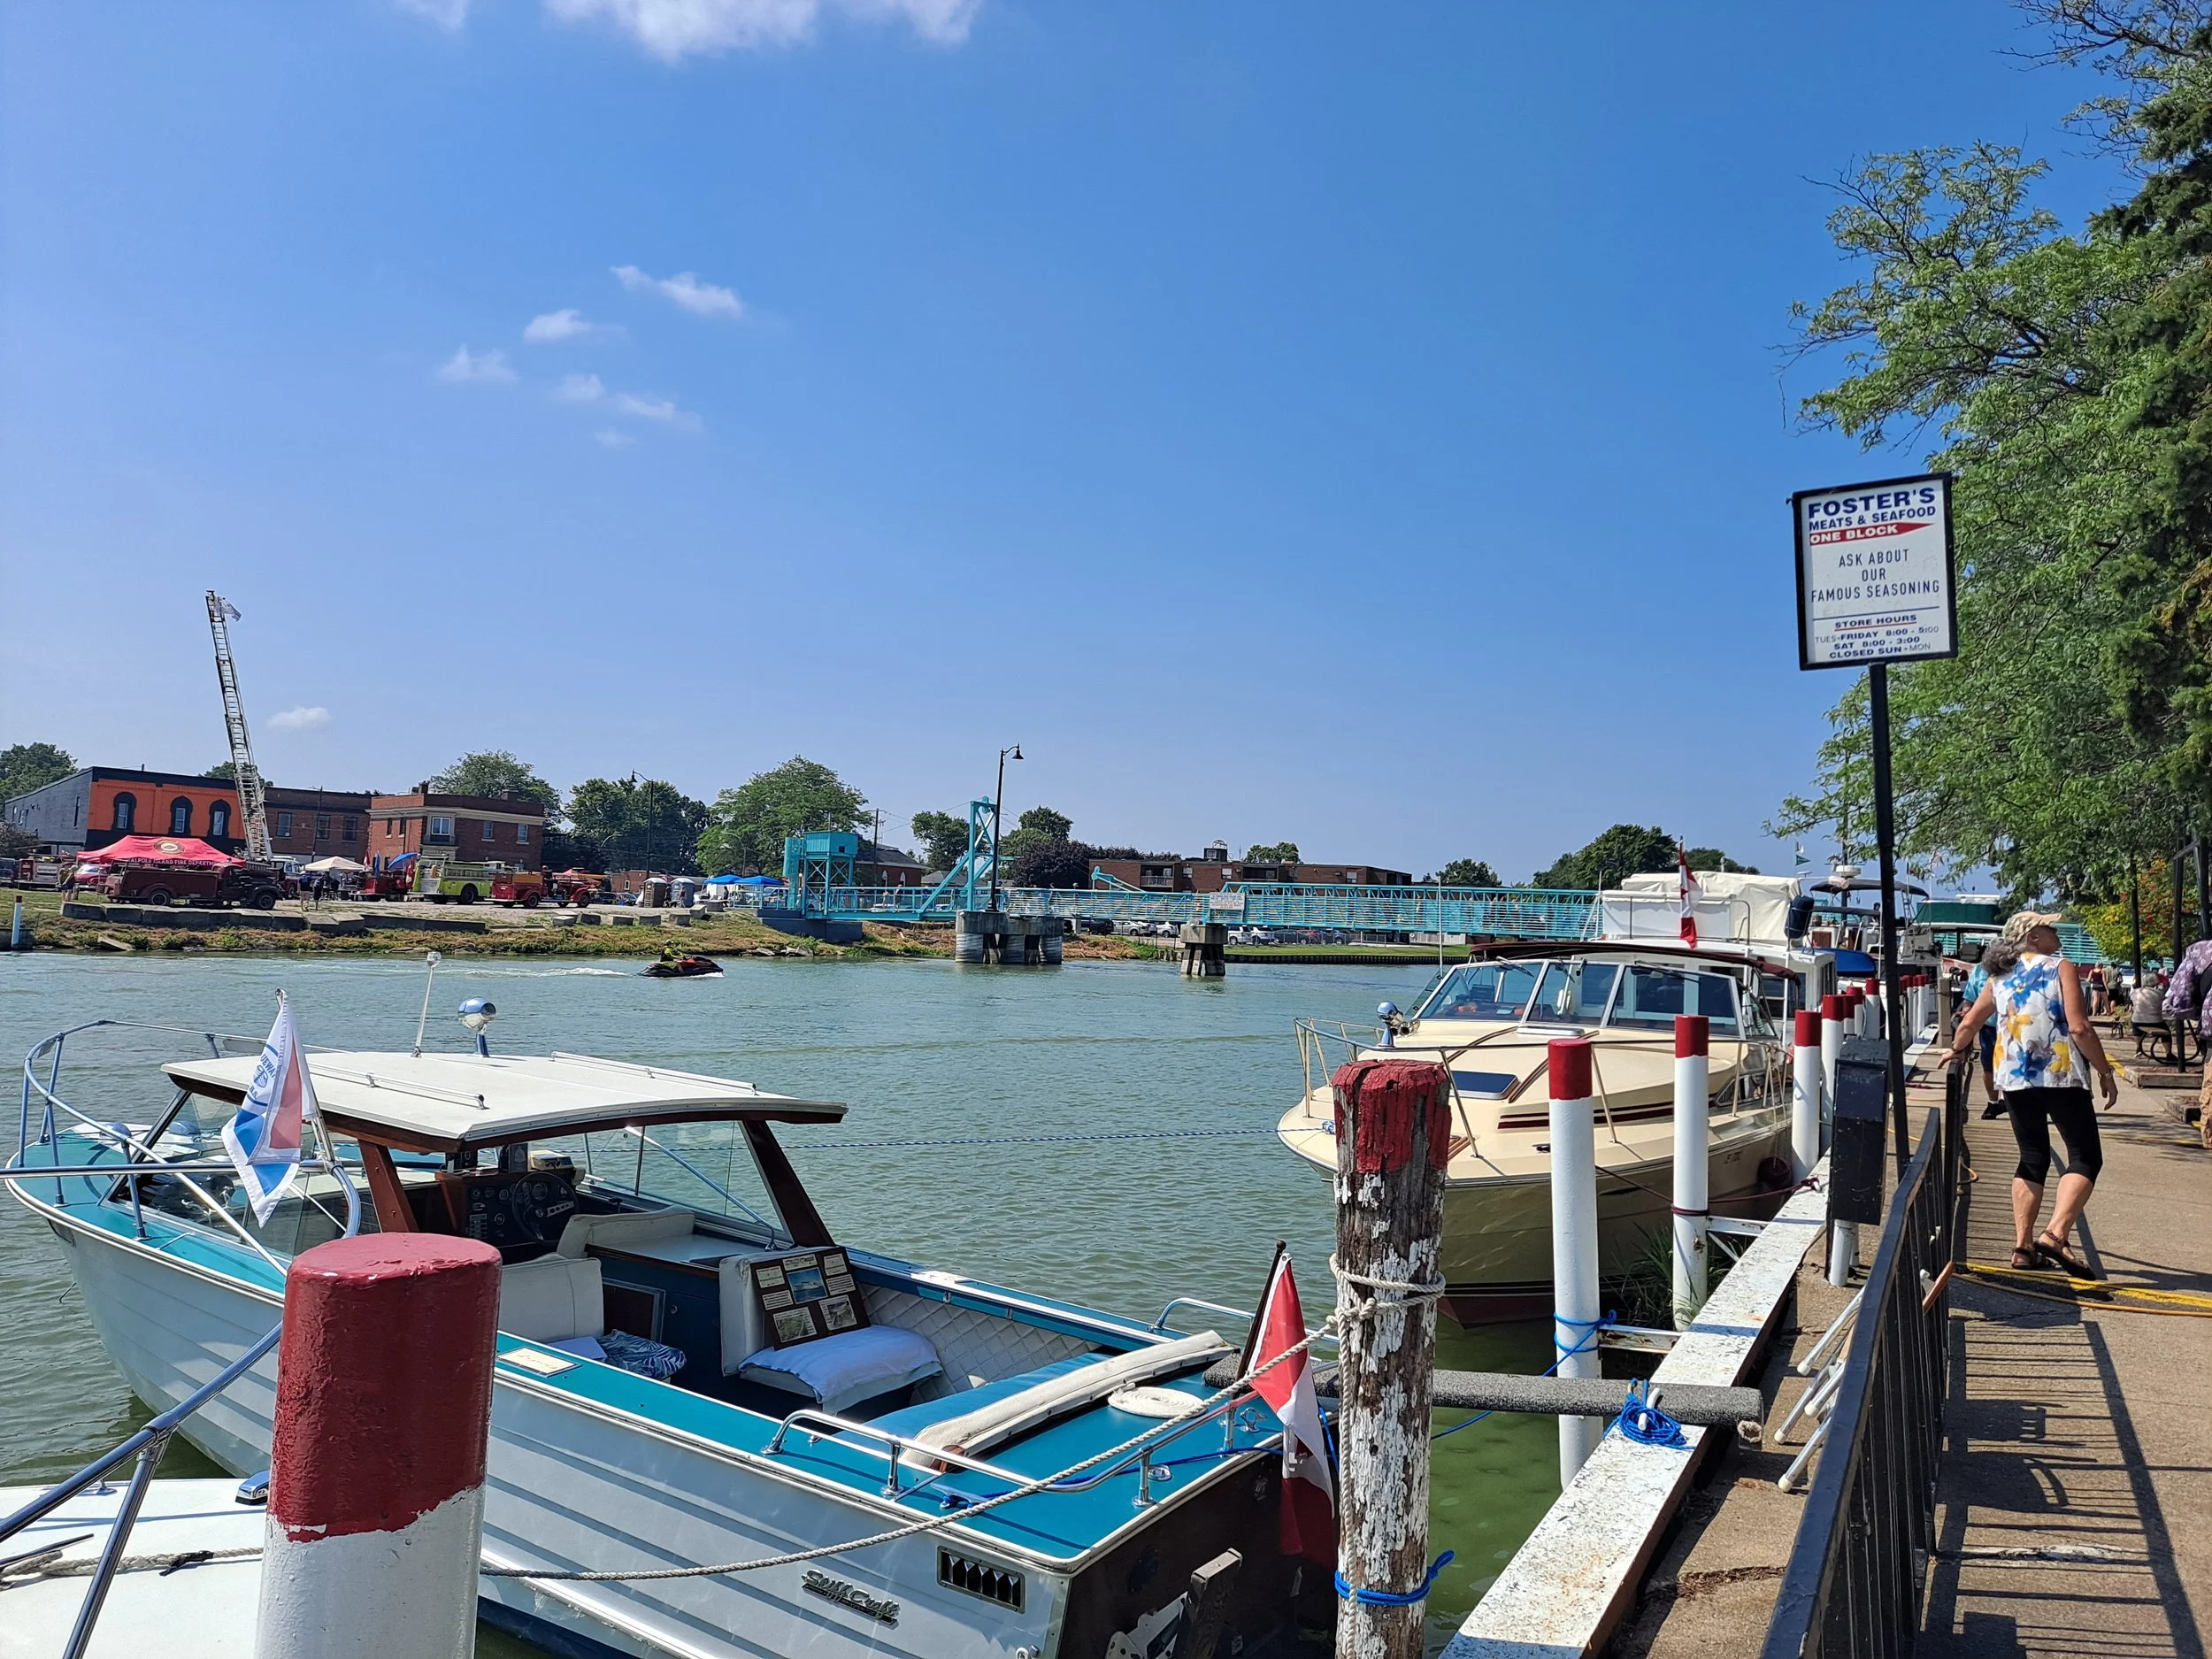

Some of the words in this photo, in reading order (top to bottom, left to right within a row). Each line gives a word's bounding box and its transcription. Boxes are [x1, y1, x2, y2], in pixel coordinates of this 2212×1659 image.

[1808, 488, 1935, 518] FOSTER'S
[1809, 516, 1853, 531] MEATS
[1857, 515, 1866, 526] &
[1871, 506, 1936, 523] SEAFOOD
[1810, 532, 1841, 544] ONE
[1846, 525, 1899, 540] BLOCK
[1839, 552, 1863, 567] ASK
[1868, 549, 1909, 565] ABOUT
[1862, 567, 1886, 582] OUR
[1811, 587, 1861, 603] FAMOUS
[1867, 580, 1939, 598] SEASONING
[1835, 619, 1872, 628] STORE
[1877, 614, 1917, 625] HOURS
[1829, 649, 1874, 658] CLOSED
[1833, 641, 1855, 650] SAT
